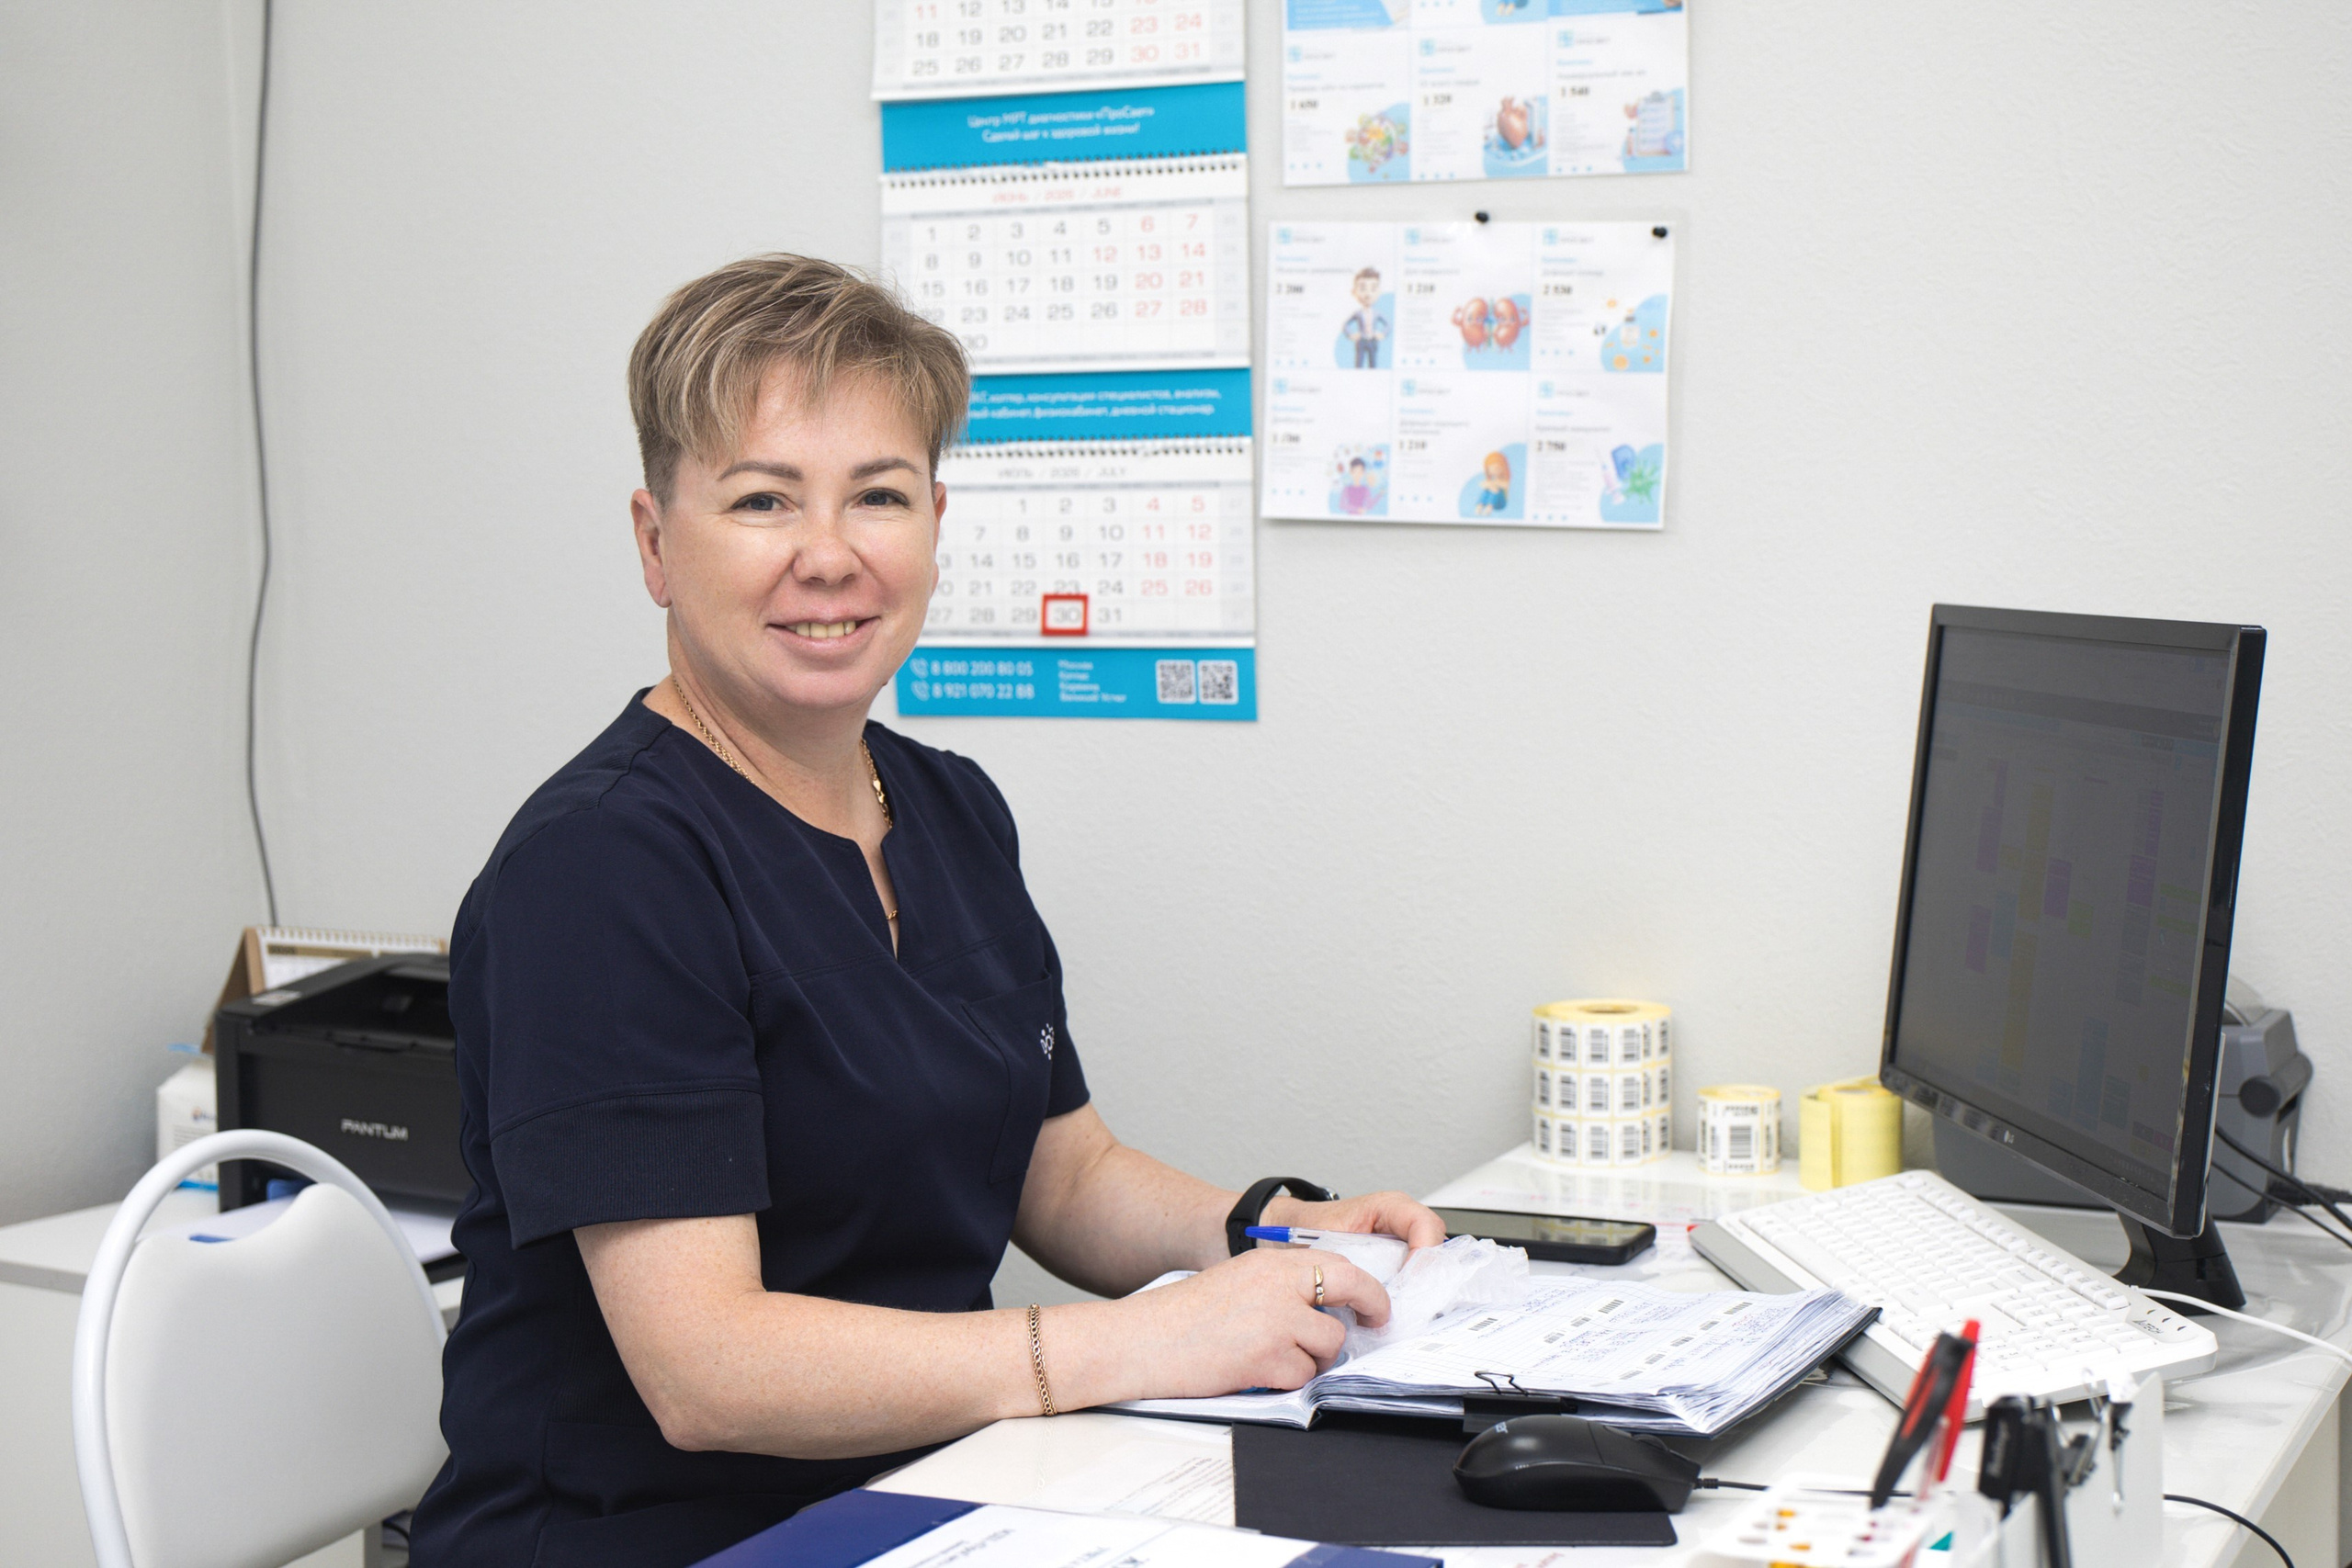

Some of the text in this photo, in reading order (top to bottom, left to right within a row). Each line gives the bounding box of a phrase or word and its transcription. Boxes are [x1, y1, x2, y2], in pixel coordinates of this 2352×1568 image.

[915, 4, 937, 20] 11
[958, 0, 982, 17] 12
[916, 31, 939, 48] 18
[958, 28, 982, 45] 19
[999, 26, 1026, 43] 20
[1042, 23, 1067, 40] 21
[1086, 19, 1114, 38] 22
[912, 59, 939, 76] 25
[956, 56, 982, 73] 26
[998, 53, 1025, 72] 27
[1042, 51, 1069, 68] 28
[1086, 48, 1114, 65] 29
[928, 226, 935, 241] 1
[967, 224, 980, 241] 2
[1011, 222, 1023, 239] 3
[1054, 220, 1067, 235] 4
[1097, 218, 1111, 235] 5
[1140, 215, 1155, 232] 6
[925, 243, 1205, 270] 8 9 10 11 12 13 14
[921, 270, 1204, 298] 15 16 17 18 19 20 21
[961, 307, 988, 323] 23
[1004, 306, 1030, 322] 24
[1047, 303, 1074, 321] 25
[1091, 302, 1118, 319] 26
[1135, 300, 1162, 318] 27
[1180, 299, 1207, 316] 28
[1019, 496, 1205, 514] 1 2 3 4 5
[1016, 526, 1029, 541] 8
[1059, 525, 1073, 541] 9
[1098, 525, 1125, 541] 10
[1143, 524, 1164, 539] 11
[1187, 524, 1212, 540] 12
[970, 554, 993, 568] 14
[1012, 553, 1036, 570] 15
[1056, 552, 1080, 570] 16
[1099, 552, 1123, 568] 17
[1144, 551, 1168, 568] 18
[1187, 551, 1213, 568] 19
[968, 580, 991, 597] 21
[1011, 581, 1036, 597] 22
[1098, 580, 1124, 595] 24
[1141, 580, 1168, 596] 25
[1185, 580, 1212, 595] 26
[970, 608, 995, 624] 28
[1012, 608, 1038, 624] 29
[1055, 607, 1080, 623] 30
[1098, 607, 1121, 623] 31
[340, 1118, 409, 1141] PANTUM
